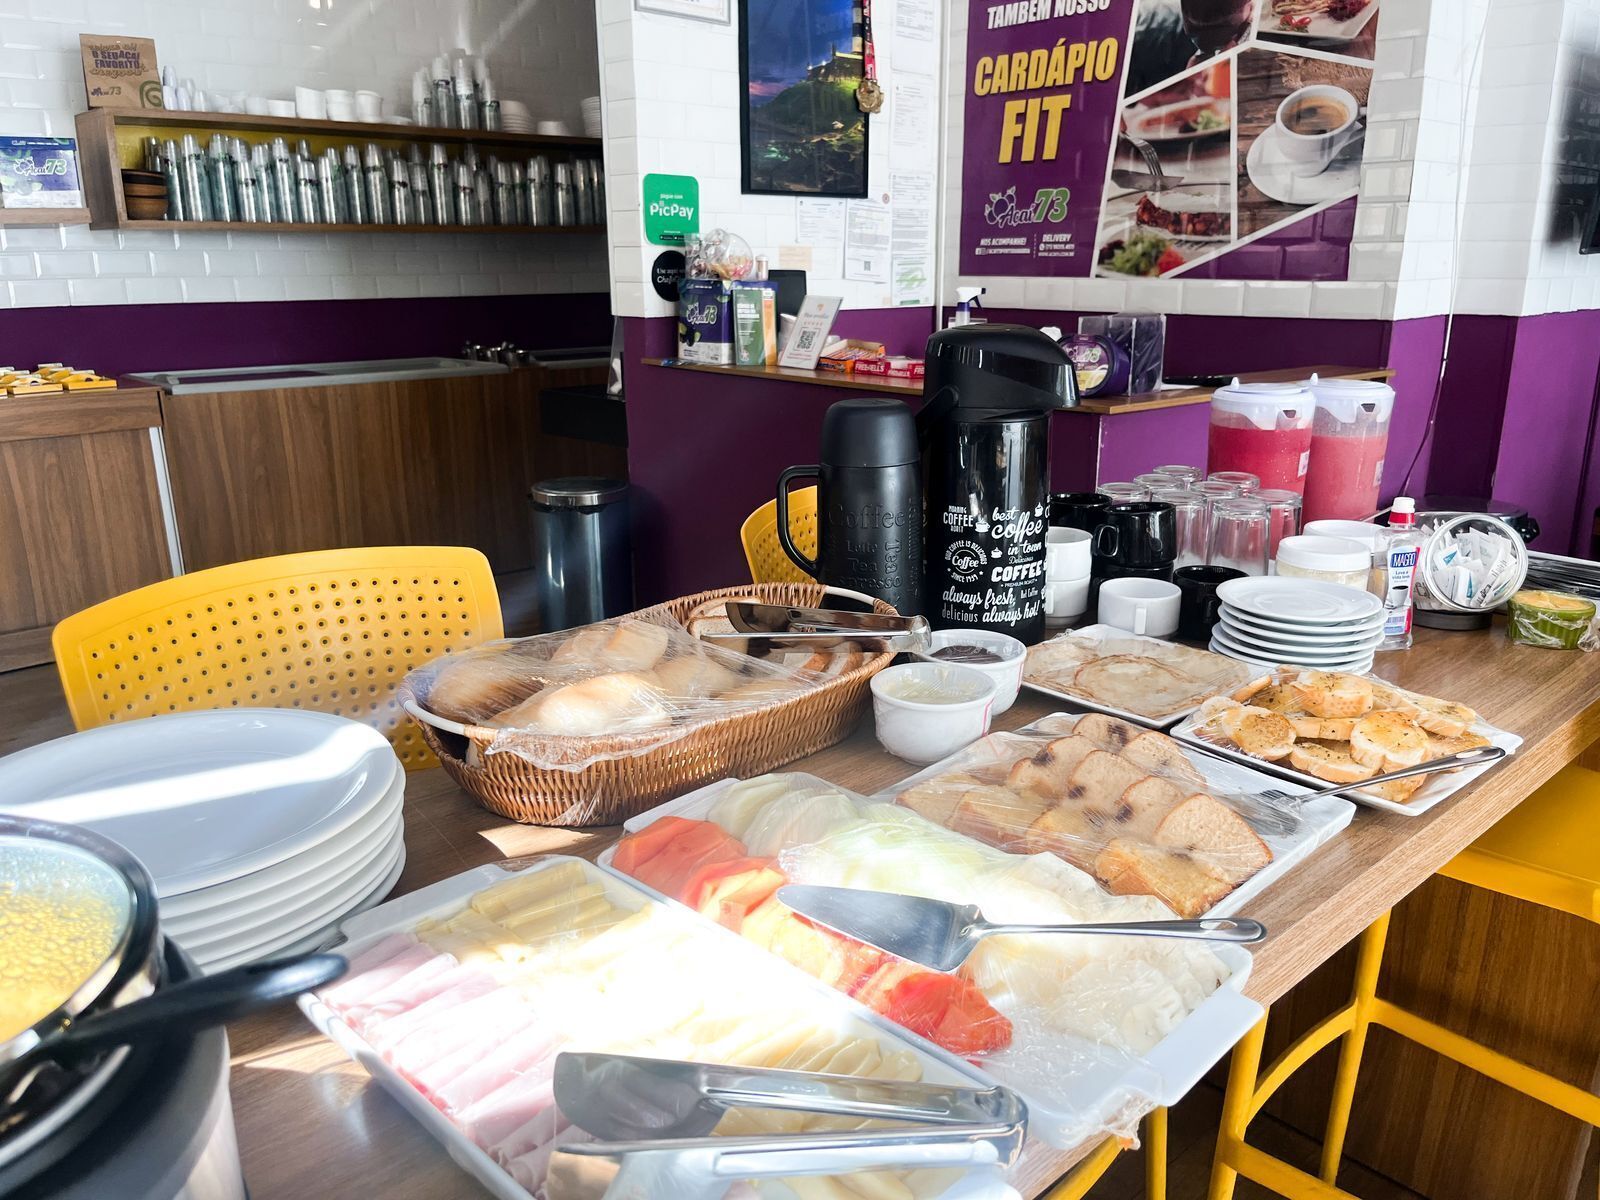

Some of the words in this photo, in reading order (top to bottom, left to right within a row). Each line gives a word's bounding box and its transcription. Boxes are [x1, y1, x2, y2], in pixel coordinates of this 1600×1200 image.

[95, 59, 140, 69] FAVORITO
[974, 37, 1119, 96] CARDÁPIO
[998, 94, 1072, 164] FIT
[650, 203, 694, 220] PicPay
[1034, 187, 1070, 222] 73
[1042, 234, 1072, 242] DELIVERY
[829, 504, 905, 529] Coffee
[943, 512, 974, 528] COFFEE
[992, 506, 1020, 521] best
[991, 511, 1043, 543] coffee
[948, 540, 965, 552] COFFEE
[965, 540, 971, 548] IS
[1008, 543, 1020, 556] in
[1019, 540, 1043, 554] town
[951, 555, 979, 570] Coffee
[991, 560, 1044, 582] COFFEE
[951, 571, 965, 583] SINCE
[942, 585, 984, 610] always
[984, 588, 1016, 609] fresh,
[942, 602, 979, 622] delicious
[982, 606, 1023, 627] always
[1023, 600, 1041, 620] hot!
